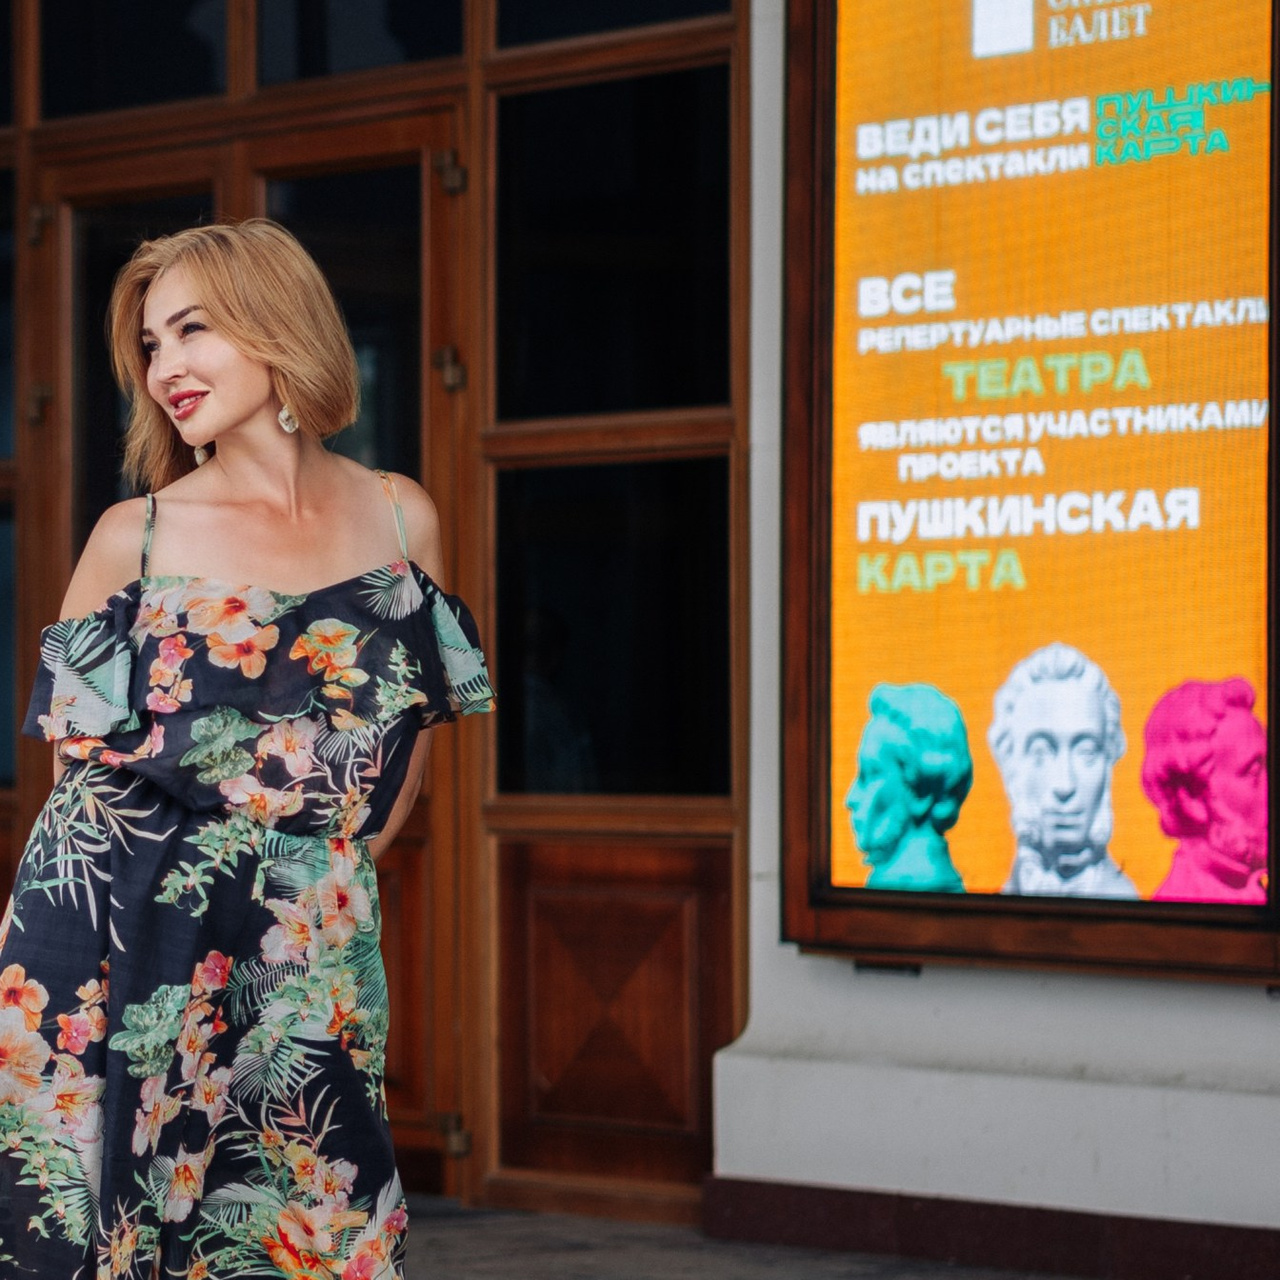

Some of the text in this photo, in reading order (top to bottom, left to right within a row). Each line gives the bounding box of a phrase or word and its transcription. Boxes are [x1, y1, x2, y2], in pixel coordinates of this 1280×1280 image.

[1048, 4, 1152, 49] БАЛЕТ
[856, 96, 1091, 160] ВЕДИ СЕБЯ
[1096, 129, 1229, 166] КАРТА
[858, 269, 956, 318] ВСЕ
[858, 311, 1087, 355] РЕПЕРТУАРНЫЕ
[942, 349, 1150, 401] ТЕАТРА
[858, 412, 1024, 450] ЯВЛЯЮТСЯ
[898, 447, 1046, 482] ПРОЕКТА
[856, 487, 1200, 543] ПУШКИНСКАЯ
[857, 548, 1027, 594] КАРТА
